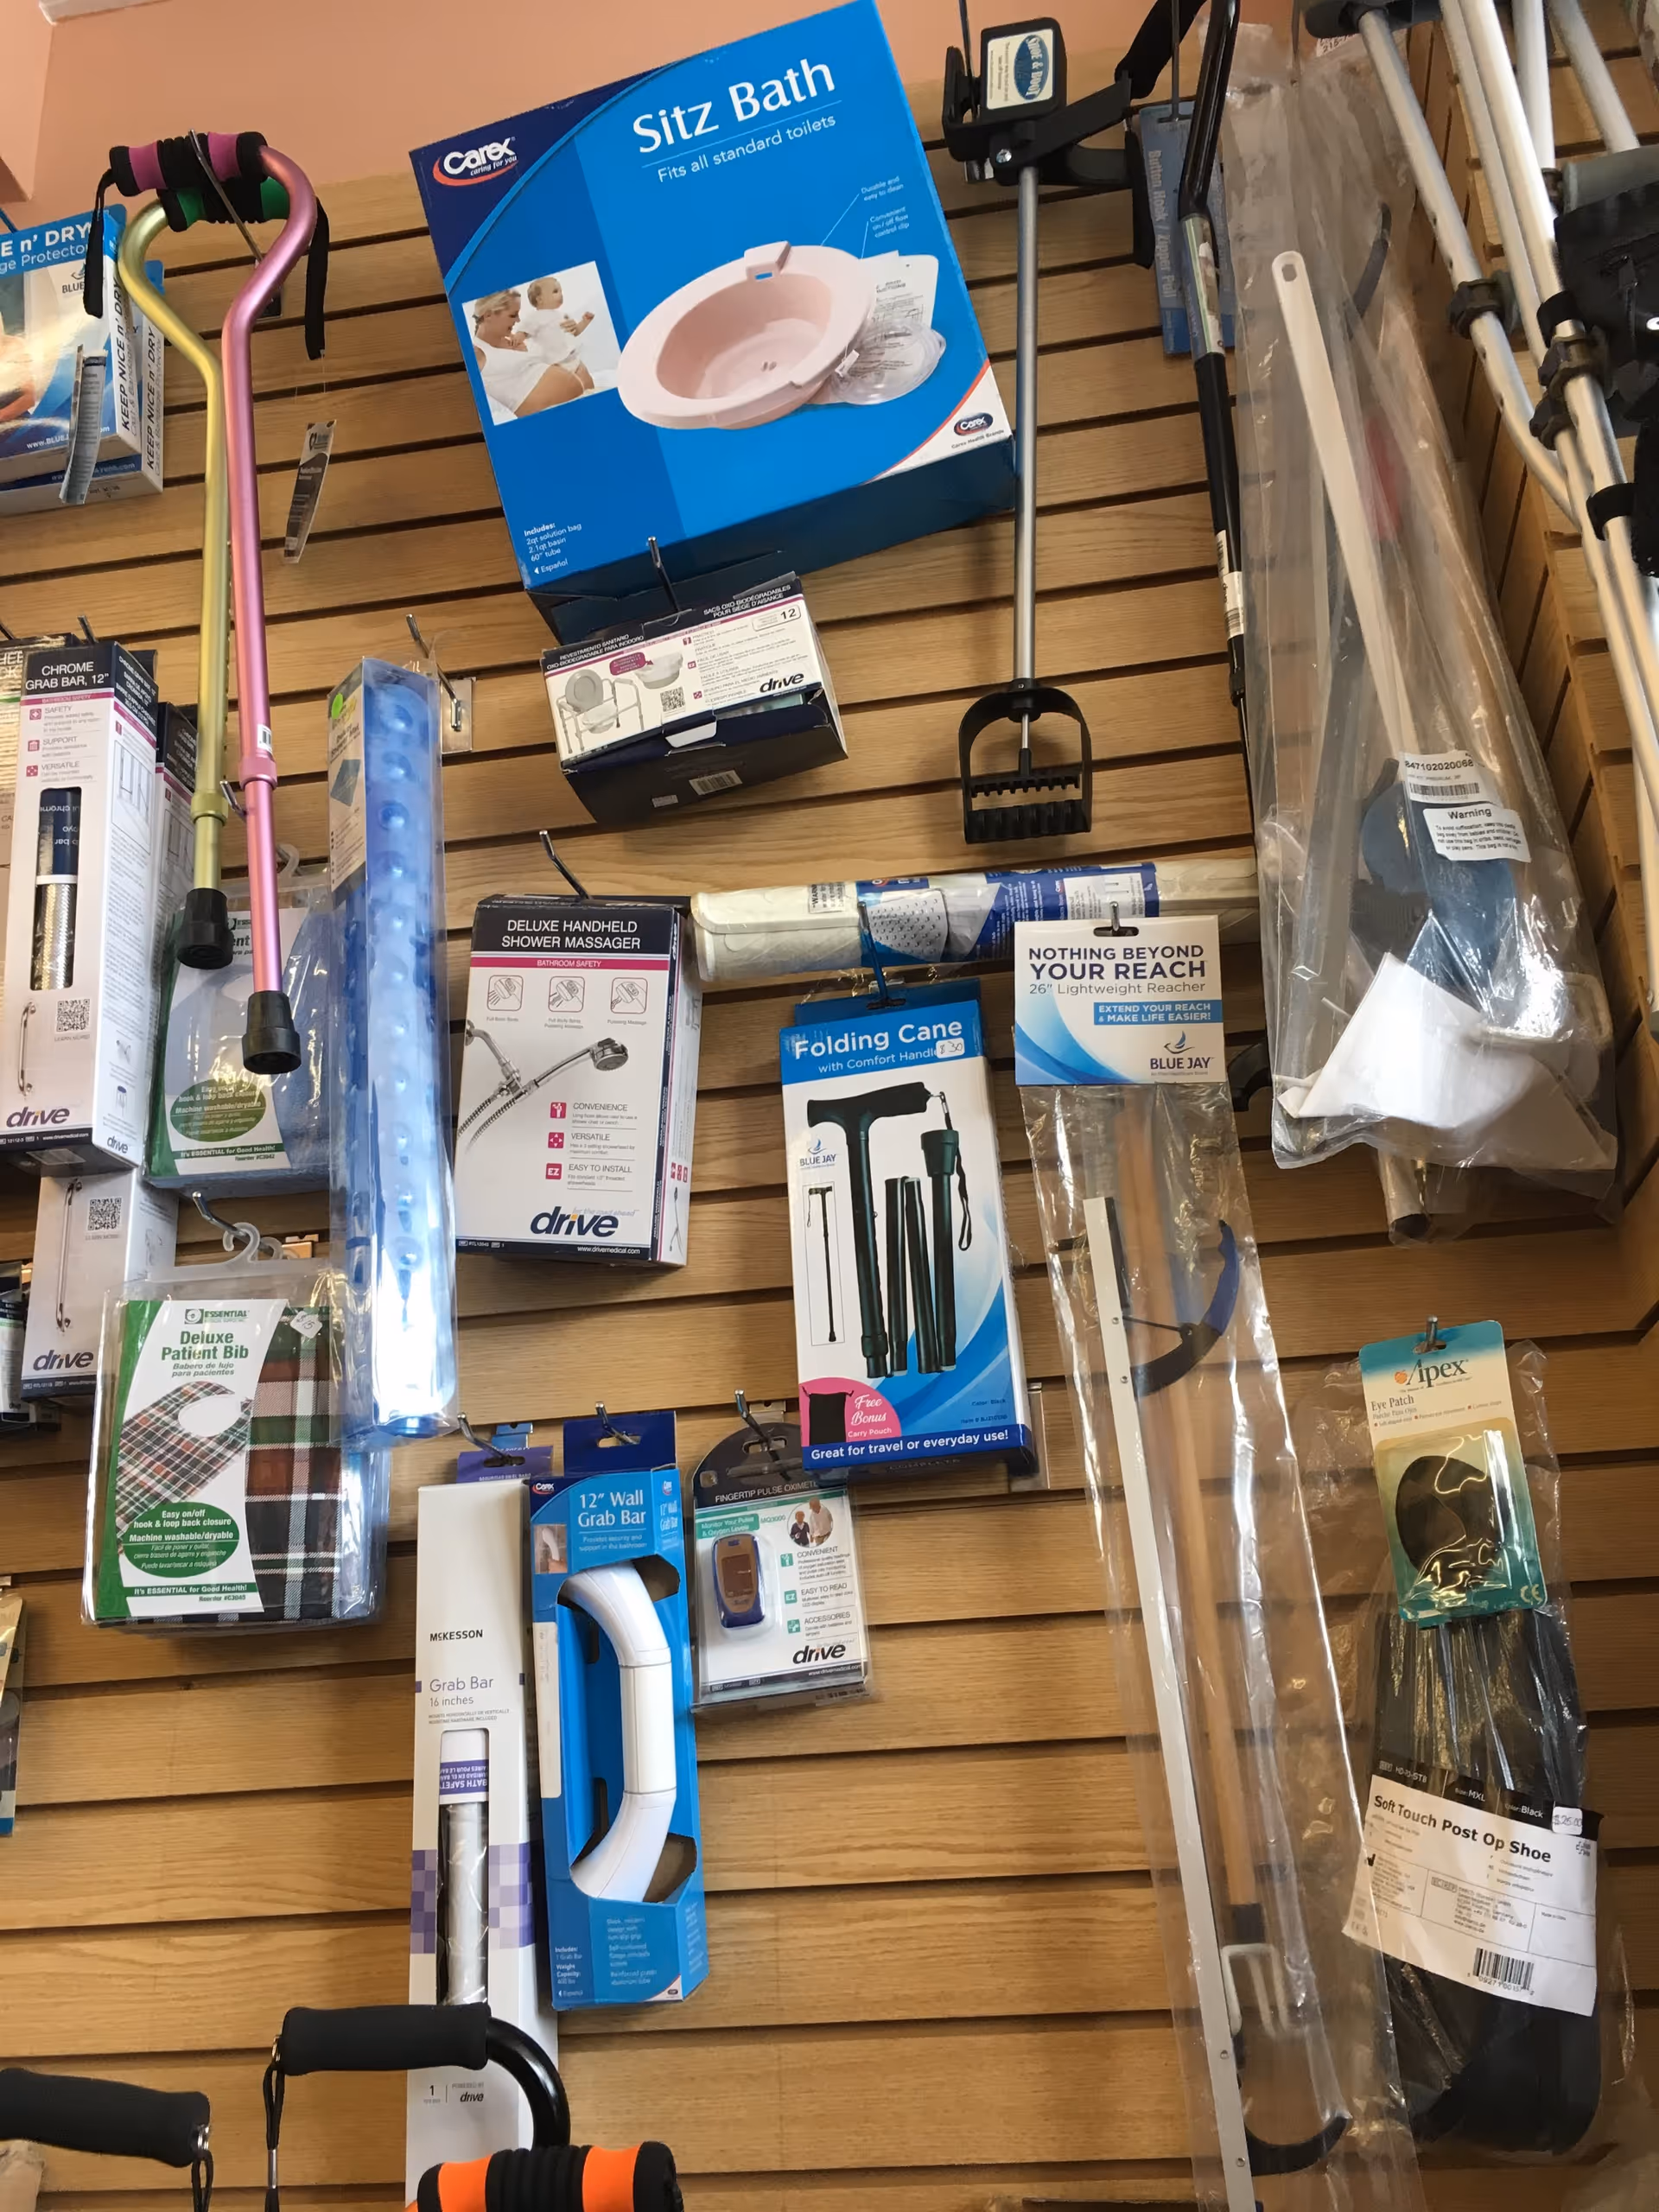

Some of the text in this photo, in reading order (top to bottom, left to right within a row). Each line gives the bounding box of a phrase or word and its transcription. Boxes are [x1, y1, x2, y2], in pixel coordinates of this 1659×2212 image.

[632, 59, 834, 154] Sitz Bath
[658, 115, 836, 182] Fits all standard toilets
[443, 137, 516, 175] Carex
[470, 156, 517, 176] caring for you
[1147, 149, 1163, 188] Button
[1154, 190, 1168, 221] Hook
[45, 221, 92, 247] DRY
[117, 335, 130, 431] KEEP NICE
[961, 416, 986, 430] Carex
[524, 523, 556, 537] Includes:
[539, 524, 582, 541] solution bag
[548, 537, 566, 547] basin
[541, 558, 569, 572] Español
[703, 607, 721, 615] SACS
[780, 608, 797, 620] 12
[41, 661, 94, 676] CHROME
[25, 673, 110, 690] GRAB BAR, 12"
[760, 673, 804, 693] drive
[45, 706, 73, 715] SAFETY
[43, 736, 78, 746] SUPPORT
[41, 761, 79, 771] VERSATILE
[1447, 807, 1492, 820] Warning
[507, 919, 638, 933] DELUXE HANDHELD
[501, 935, 640, 949] SHOWER MASSAGER
[1029, 944, 1204, 961] NOTHING BEYOND
[1030, 960, 1205, 981] YOUR REACH
[1029, 982, 1205, 995] 26" Lightweight Reacher
[1175, 1003, 1211, 1012] REACH
[1107, 1014, 1139, 1023] MAKE
[1141, 1014, 1166, 1022] LIFE
[1168, 1012, 1211, 1021] EASIER!
[795, 1020, 963, 1060] Folding Cane
[818, 1061, 844, 1073] with
[847, 1054, 896, 1070] Comfort
[1150, 1057, 1211, 1070] BLUE JAY
[573, 1102, 628, 1112] CONVENIENCE
[6, 1107, 70, 1128] drive
[571, 1133, 610, 1141] VERSATILE
[107, 1135, 129, 1154] drive
[799, 1154, 836, 1166] BLUE JAY
[548, 1167, 560, 1176] EZ
[602, 1165, 632, 1173] INSTALL
[530, 1206, 619, 1237] drive
[577, 1246, 641, 1255] www.drivemedical.com
[181, 1331, 233, 1344] Deluxe
[162, 1345, 248, 1361] Patient Bib
[33, 1350, 93, 1372] drive
[192, 1369, 234, 1377] pacientes
[1406, 1358, 1467, 1389] Apex
[855, 1394, 883, 1410] Free
[1371, 1394, 1414, 1413] Eye Patch
[851, 1412, 887, 1426] Bonus
[848, 1427, 892, 1439] Carry Pouch
[811, 1429, 1009, 1460] Great for travel or everyday use!
[535, 1483, 555, 1491] Carex
[580, 1490, 644, 1509] 12" Wall
[715, 1491, 756, 1503] FINGERTIP
[757, 1486, 783, 1497] PULSE
[162, 1509, 207, 1519] Easy on/off
[578, 1510, 646, 1528] Grab Bar
[162, 1519, 180, 1529] loop
[182, 1517, 200, 1527] back
[203, 1517, 232, 1527] closure
[130, 1531, 234, 1542] Machine washable/dryable
[797, 1546, 838, 1559] CONVENIENT
[801, 1586, 819, 1596] EASY
[830, 1582, 848, 1592] READ
[804, 1611, 851, 1625] ACCESSORIES
[792, 1643, 846, 1665] drive
[429, 1675, 494, 1692] Grab Bar
[429, 1695, 474, 1707] 16 inches
[440, 1778, 487, 1789] BATH SAFET
[1374, 1795, 1396, 1814] Soft
[1398, 1803, 1437, 1828] Touch
[1441, 1819, 1478, 1841] Post
[1483, 1833, 1505, 1852] Op
[1510, 1840, 1552, 1863] Shoe
[429, 2084, 434, 2096] 1
[460, 2091, 484, 2102] drive
